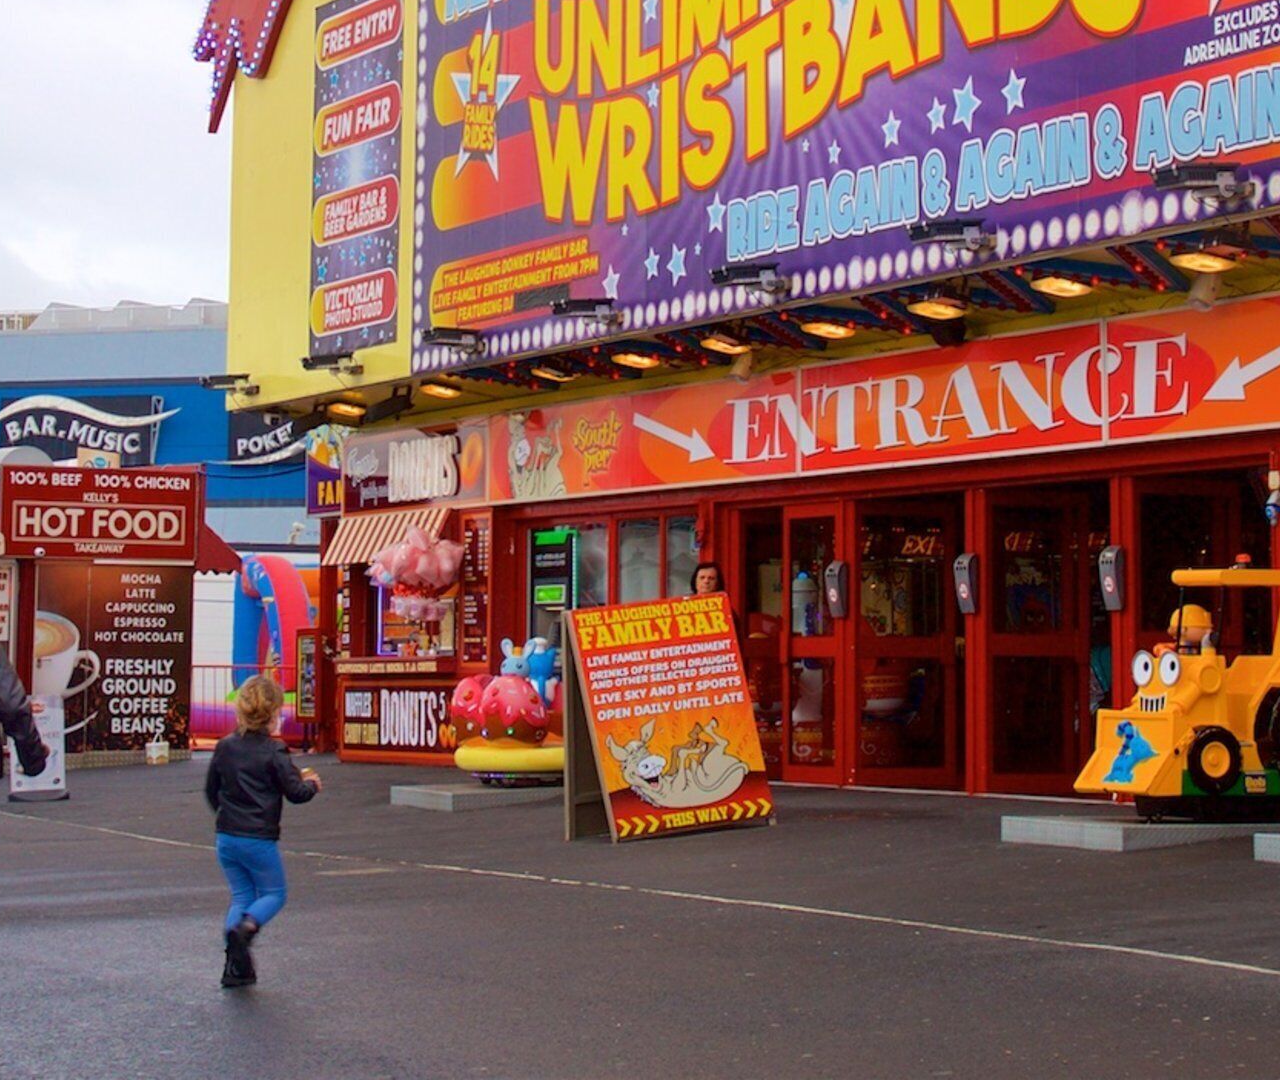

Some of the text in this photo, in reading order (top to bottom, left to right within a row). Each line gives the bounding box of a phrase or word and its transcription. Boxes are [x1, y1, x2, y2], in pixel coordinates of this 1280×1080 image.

[322, 6, 397, 55] FREE ENTRY
[1214, 2, 1279, 36] EXCLUDES
[1184, 32, 1262, 67] ADRENALINE
[468, 31, 500, 98] 14
[323, 97, 391, 145] FUN FAIR
[465, 102, 495, 123] FAMILY
[463, 123, 495, 151] RIDES
[726, 188, 798, 261] RIDE
[805, 159, 918, 241] AGAIN
[920, 155, 950, 216] &
[956, 112, 1090, 211] AGAIN
[1092, 103, 1128, 176] &
[324, 187, 387, 220] FAMILY BAR &
[324, 204, 387, 238] BEER GARDENS
[444, 238, 589, 288] THE LAUGHING DONKEY FAMILY BAR
[324, 279, 384, 311] VICTORIAN
[434, 254, 599, 310] LIVE FAMILY ENTERTAINMENT FROM 7PM
[324, 308, 351, 328] PHOTO
[458, 295, 515, 322] FEATURING DJ
[723, 332, 1189, 467] ENTRANCE
[572, 409, 622, 451] South
[10, 472, 190, 490] 100% BEEF 100% CHICKEN
[388, 435, 458, 503] DONUTS
[83, 492, 118, 504] KELLY'S
[20, 507, 179, 540] HOT FOOD
[74, 543, 124, 554] TAKEAWAY
[121, 574, 161, 584] MOCHA
[105, 603, 175, 613] CAPPUCCINO
[126, 589, 156, 599] LATTE
[114, 618, 166, 628] ESPRESSO
[576, 597, 723, 627] THE LAUGHING DONKEY
[95, 632, 184, 643] HOT CHOCOLATE
[578, 611, 729, 650] FAMILY BAR
[105, 659, 174, 675] FRESHLY
[587, 639, 731, 667] LIVE FAMILY ENTERTAINMENT
[590, 653, 735, 681] DRINKS OFFERS ON DRAUGHT
[102, 678, 176, 695] GROUND
[591, 679, 614, 690] AND
[615, 675, 648, 687] OTHER
[650, 669, 698, 682] SELECTED
[594, 677, 741, 704] LIVE SKY AND BT SPORTS
[109, 698, 168, 714] COFFEE
[380, 689, 437, 747] DONUTS
[597, 692, 744, 721] OPEN DAILY UNTIL LATE
[111, 717, 165, 734] BEANS
[663, 807, 728, 828] THIS WAY
